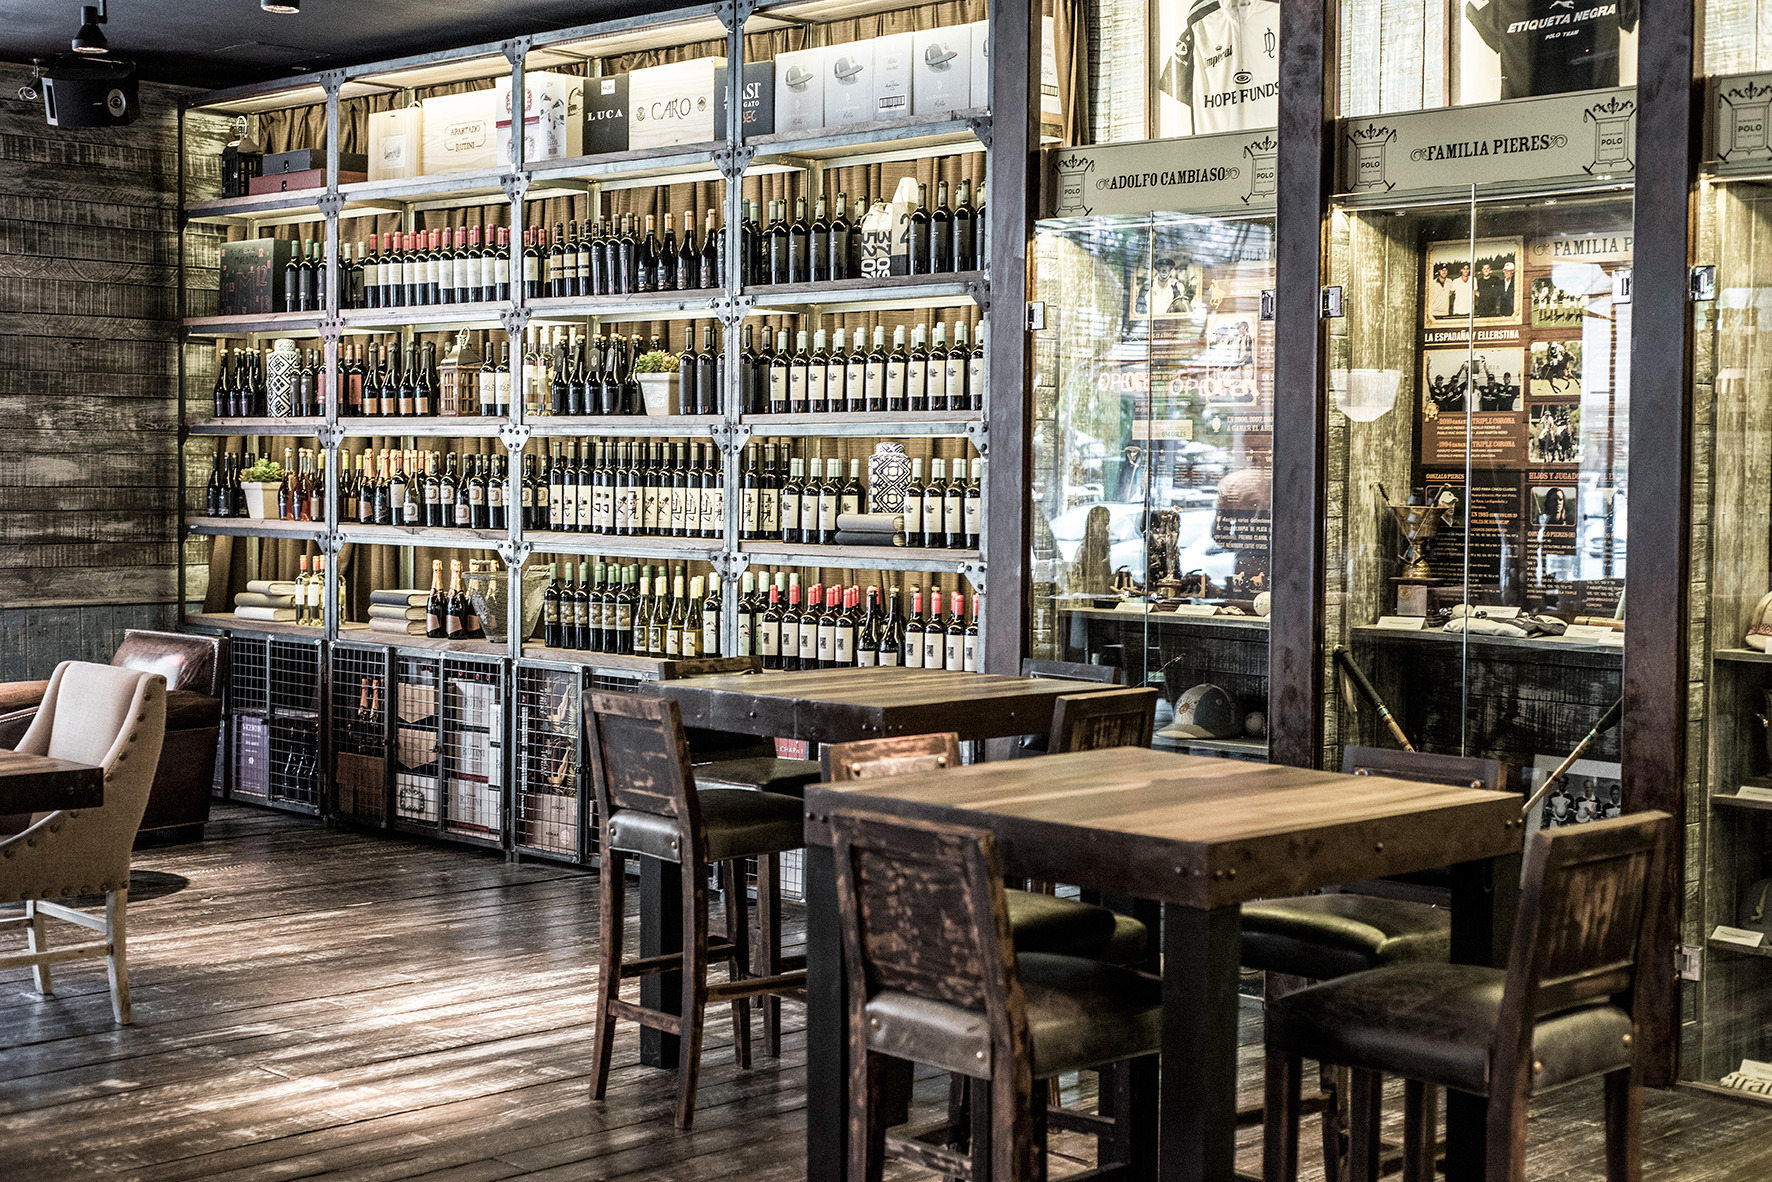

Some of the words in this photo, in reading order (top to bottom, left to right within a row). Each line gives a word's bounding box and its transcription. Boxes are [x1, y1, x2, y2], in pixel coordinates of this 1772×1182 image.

[1507, 14, 1570, 33] ETIQUETA
[1573, 4, 1616, 23] NEGRA
[1545, 32, 1561, 40] POLO
[1562, 29, 1579, 37] TEAM
[1204, 91, 1237, 108] HOPE
[587, 109, 623, 121] LUCA
[651, 98, 692, 120] CARO
[450, 125, 480, 136] APARTADO
[1738, 124, 1762, 133] POLO
[455, 141, 475, 152] RUTINI
[1427, 139, 1489, 161] FAMILIA
[1492, 134, 1550, 154] PIERES
[1601, 137, 1623, 146] POLO
[1110, 173, 1157, 190] ADOLFO
[1160, 167, 1225, 186] CAMBIASO
[1554, 238, 1618, 256] FAMILIA
[1425, 333, 1433, 342] LA
[1435, 330, 1470, 341] ESPADAÑA
[1478, 330, 1519, 340] ELLERSTINA
